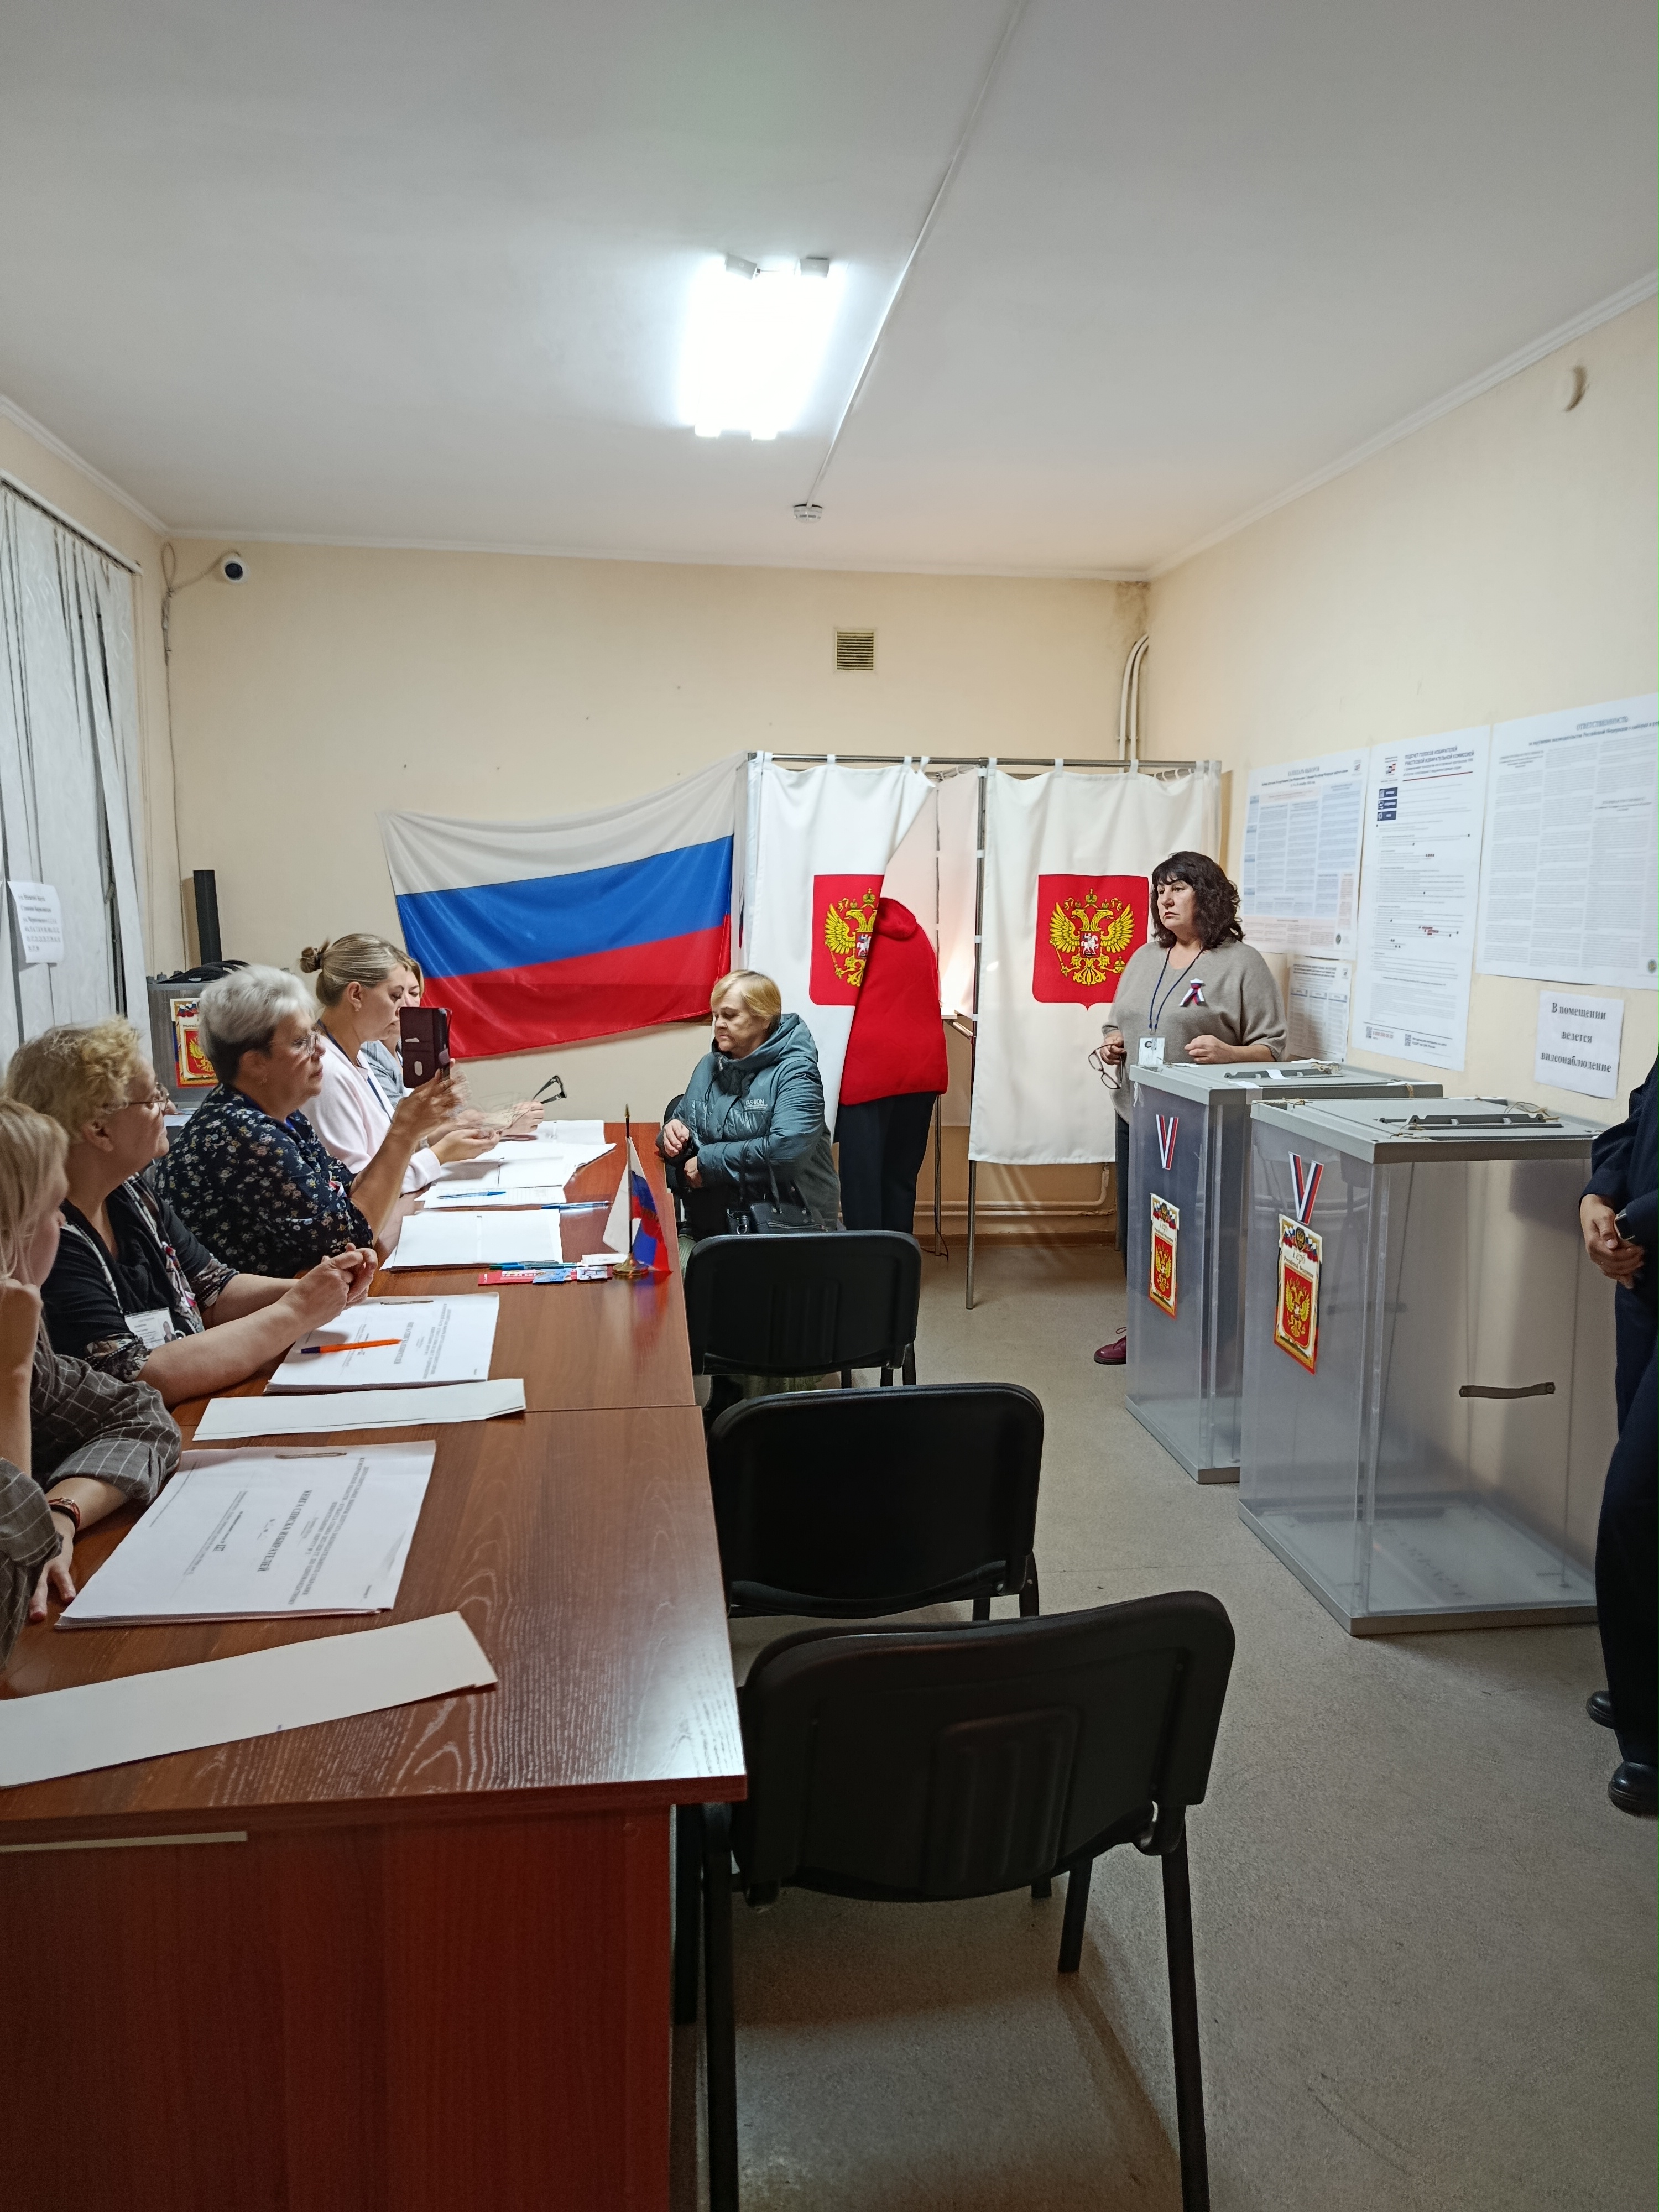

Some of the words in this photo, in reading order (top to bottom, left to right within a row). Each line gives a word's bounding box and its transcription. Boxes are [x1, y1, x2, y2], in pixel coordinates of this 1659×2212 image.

[1551, 1002, 1558, 1013] В
[1558, 1005, 1606, 1020] помещении
[1561, 1031, 1593, 1044] ведется
[1540, 1052, 1611, 1073] видеонаблюдение
[1292, 1248, 1306, 1265] Герб
[295, 1490, 312, 1507] КНИГА
[282, 1507, 301, 1530] СПИСКА
[257, 1531, 289, 1572] ИЗБИРАТЕЛЕЙ
